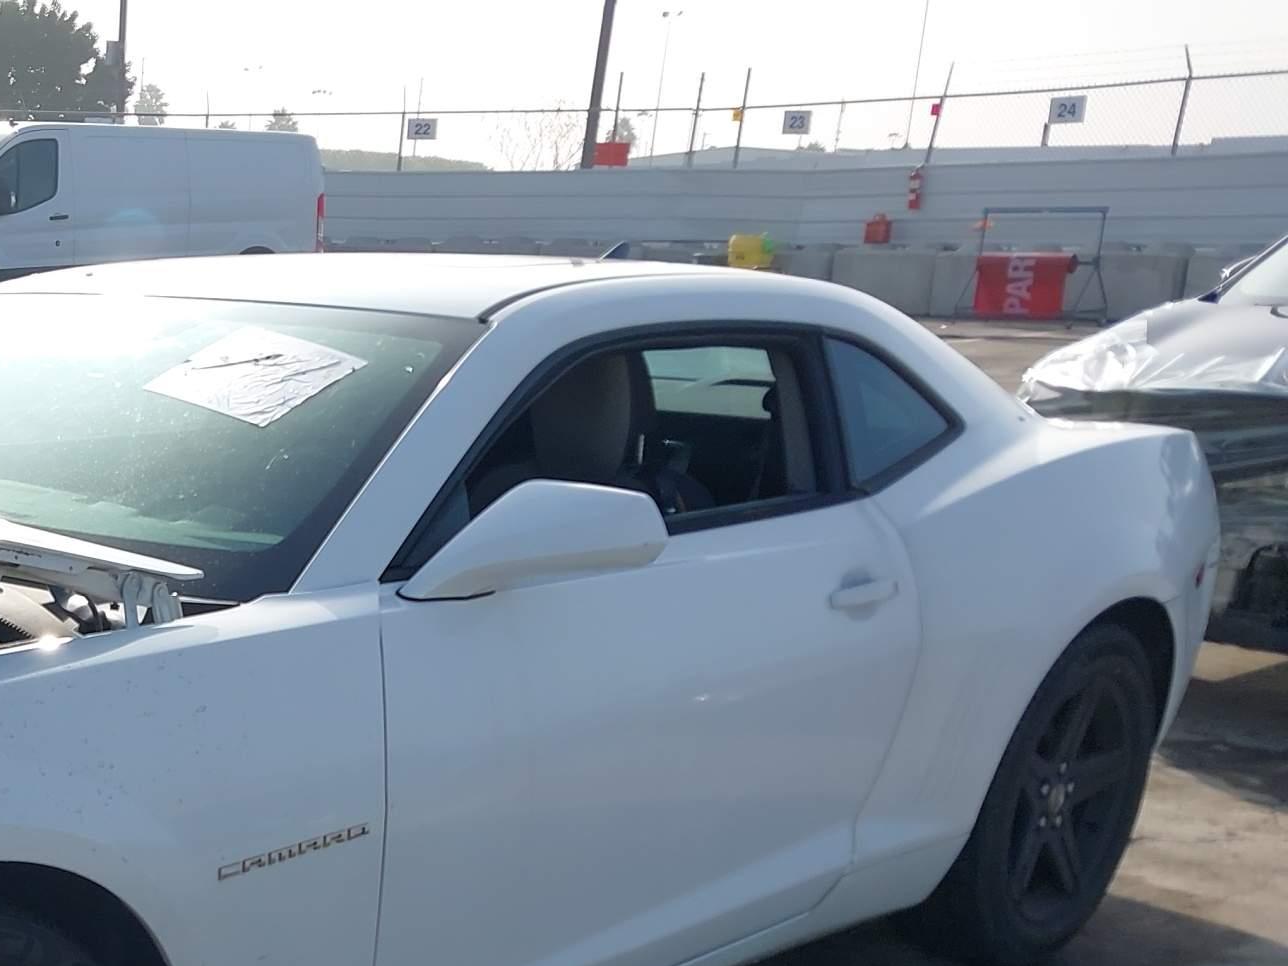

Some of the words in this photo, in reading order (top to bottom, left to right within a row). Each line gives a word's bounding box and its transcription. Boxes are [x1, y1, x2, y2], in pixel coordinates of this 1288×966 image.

[1057, 102, 1077, 118] 24
[414, 122, 431, 136] 22
[789, 115, 806, 129] 23
[217, 822, 370, 881] CAMARO
